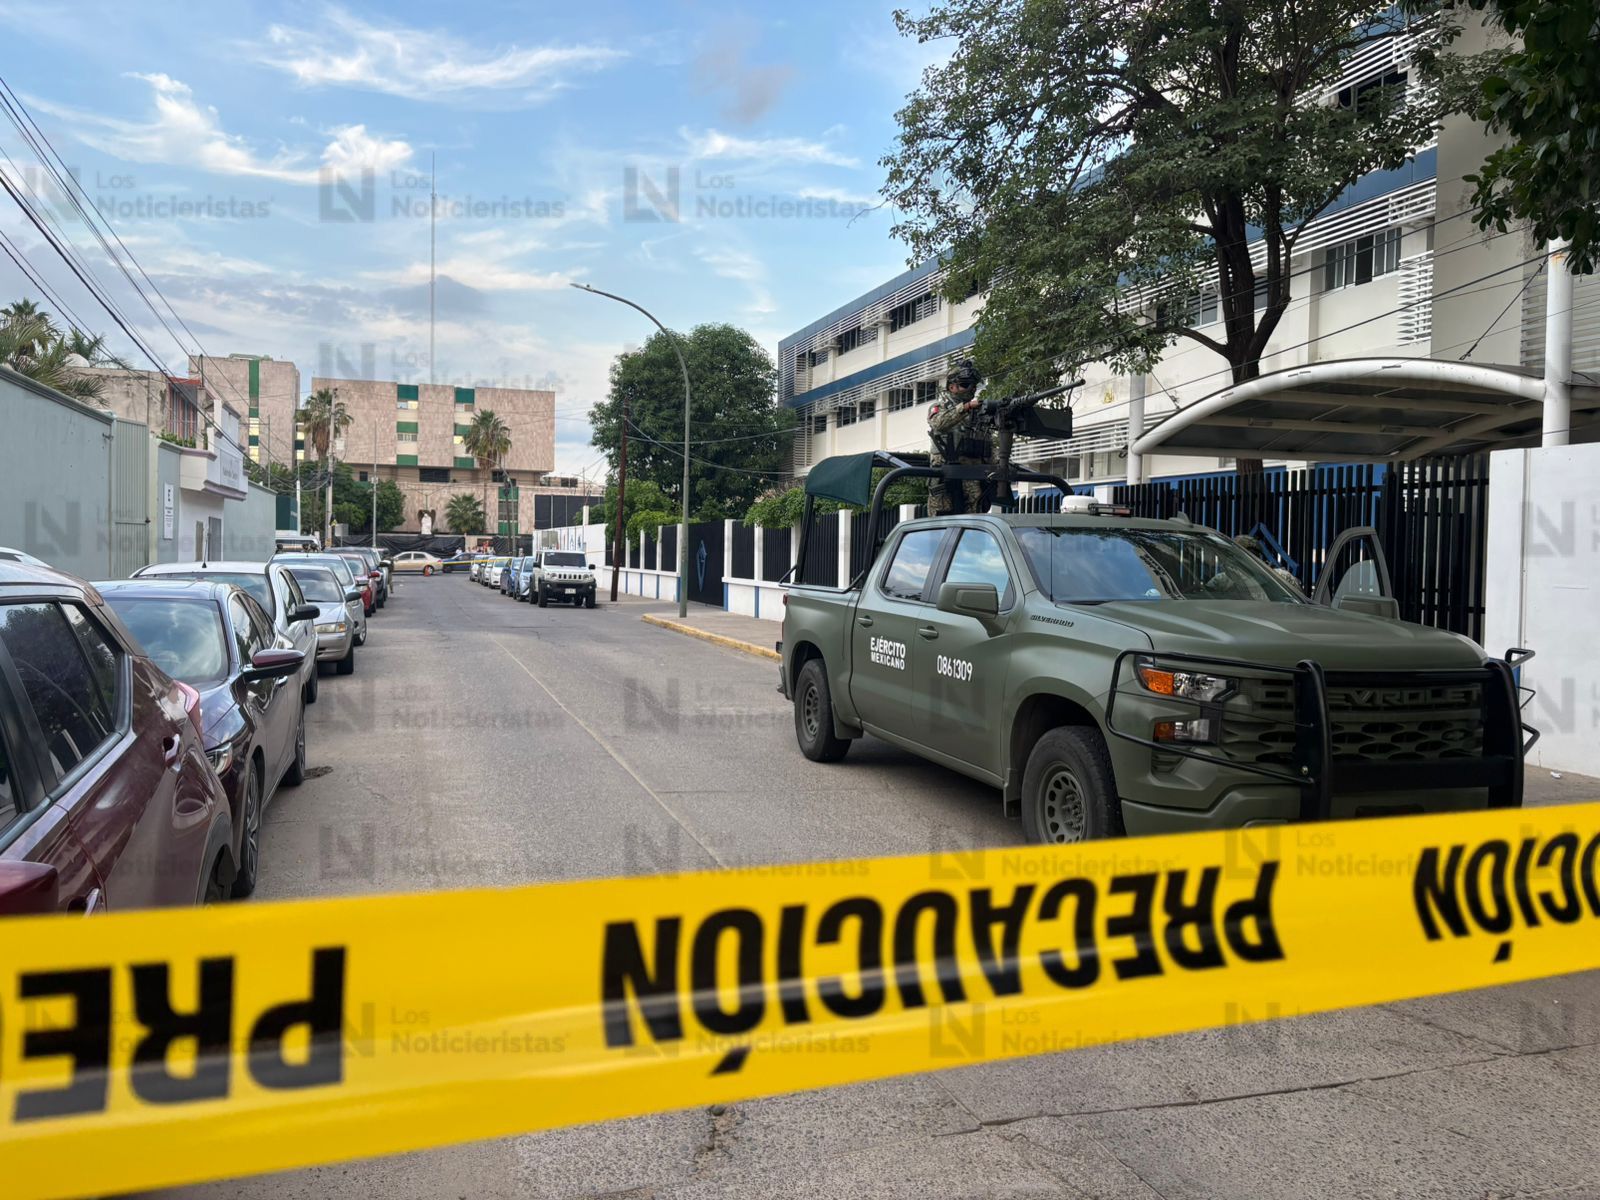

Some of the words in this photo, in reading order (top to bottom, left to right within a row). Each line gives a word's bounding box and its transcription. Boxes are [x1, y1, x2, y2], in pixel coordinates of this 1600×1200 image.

[870, 636, 906, 659] EJÉRCITO
[870, 651, 905, 671] MEXICANO
[936, 654, 973, 682] 0861309
[1252, 683, 1482, 708] CEVROLET
[601, 862, 1286, 1076] PRECAUCIÓN
[0, 944, 347, 1123] PRE
